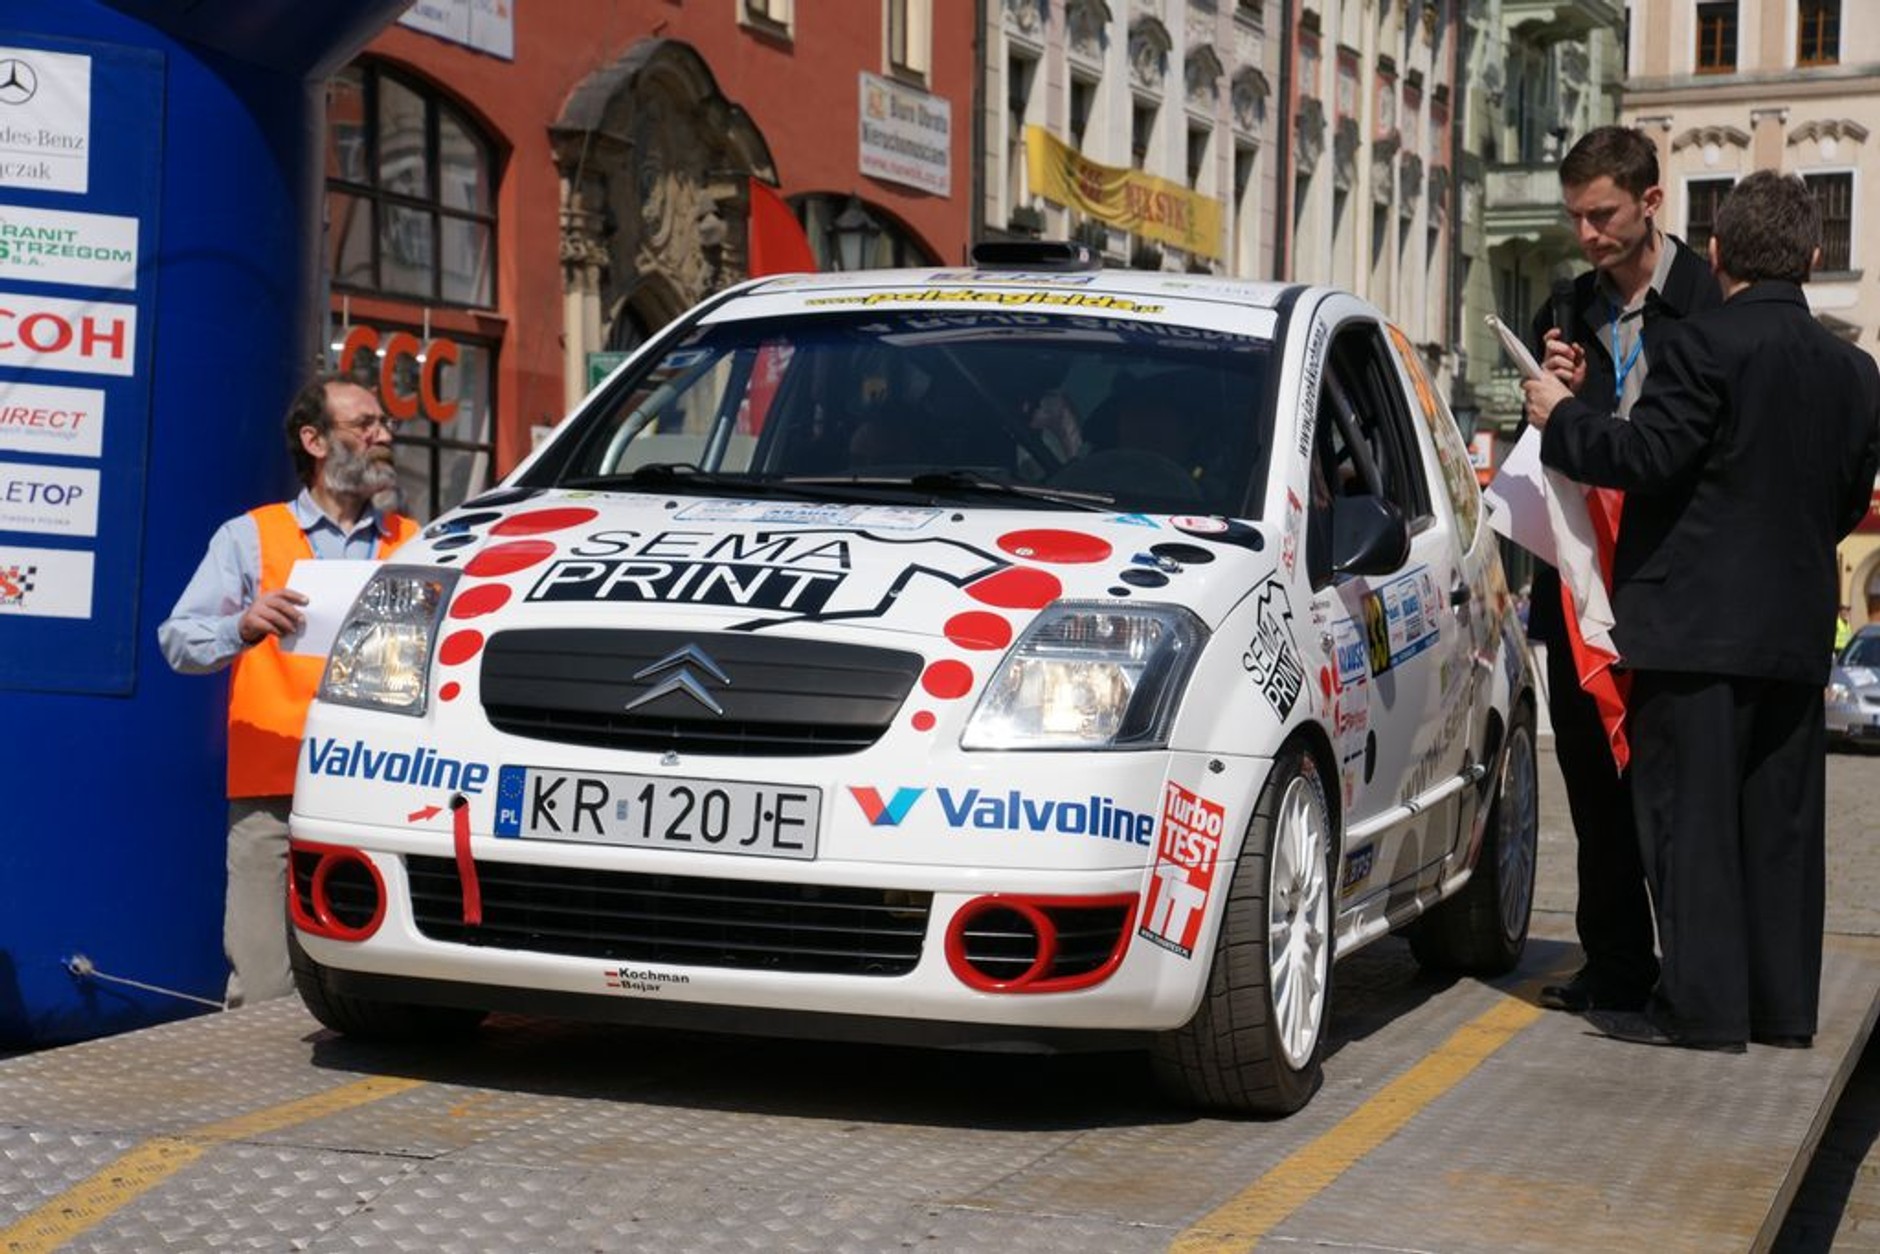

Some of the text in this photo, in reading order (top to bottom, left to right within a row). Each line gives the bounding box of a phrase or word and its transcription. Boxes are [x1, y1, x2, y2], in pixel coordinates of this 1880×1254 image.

[339, 324, 460, 424] CCC
[0, 481, 83, 506] ETOP
[570, 530, 851, 570] SEMA
[531, 561, 840, 609] PRINT
[1242, 611, 1285, 686] SEMA
[1263, 645, 1303, 722] PRINT
[308, 737, 490, 794] Valvoline
[501, 809, 518, 826] PL
[530, 776, 610, 835] KR
[937, 787, 1154, 845] Valvoline
[1167, 784, 1222, 836] Turbo
[1163, 818, 1217, 873] TEST
[619, 967, 690, 984] Kochman
